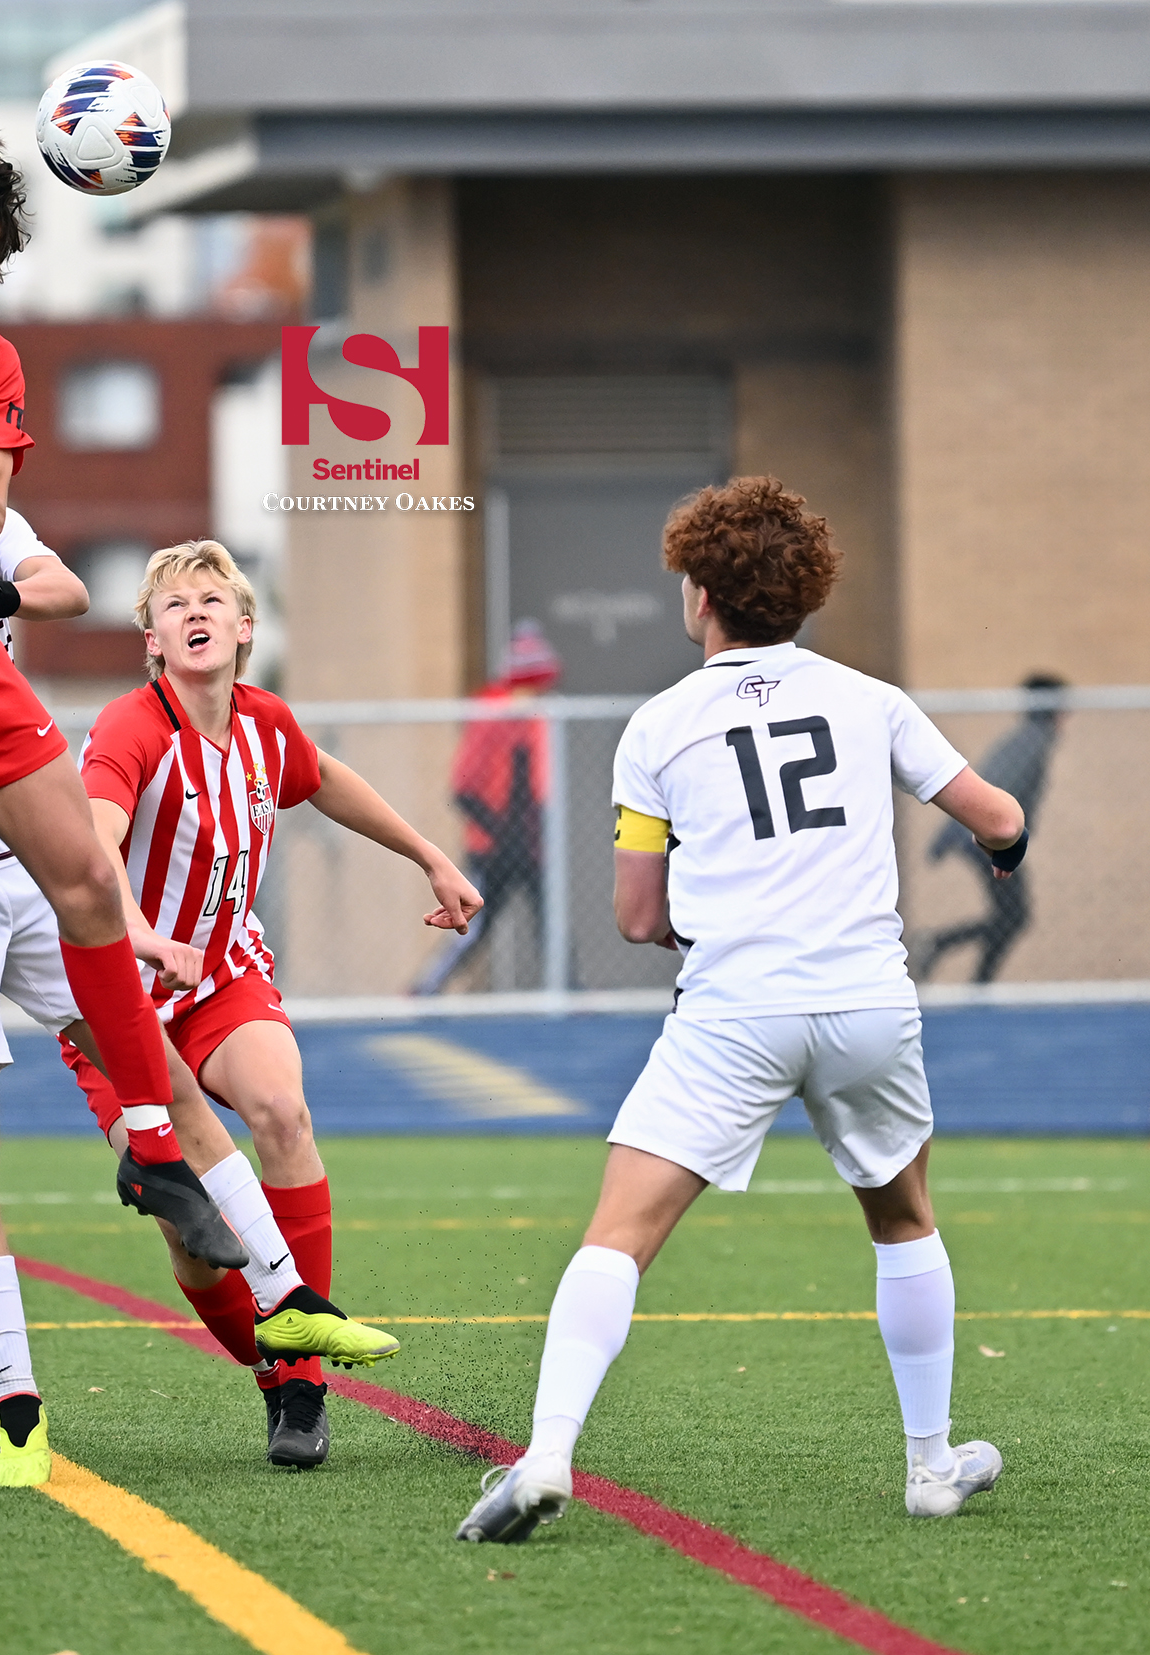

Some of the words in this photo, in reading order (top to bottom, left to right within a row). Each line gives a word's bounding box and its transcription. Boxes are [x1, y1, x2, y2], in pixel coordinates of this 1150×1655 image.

[252, 800, 272, 817] EAST
[725, 715, 847, 841] 12
[203, 850, 249, 916] 14
